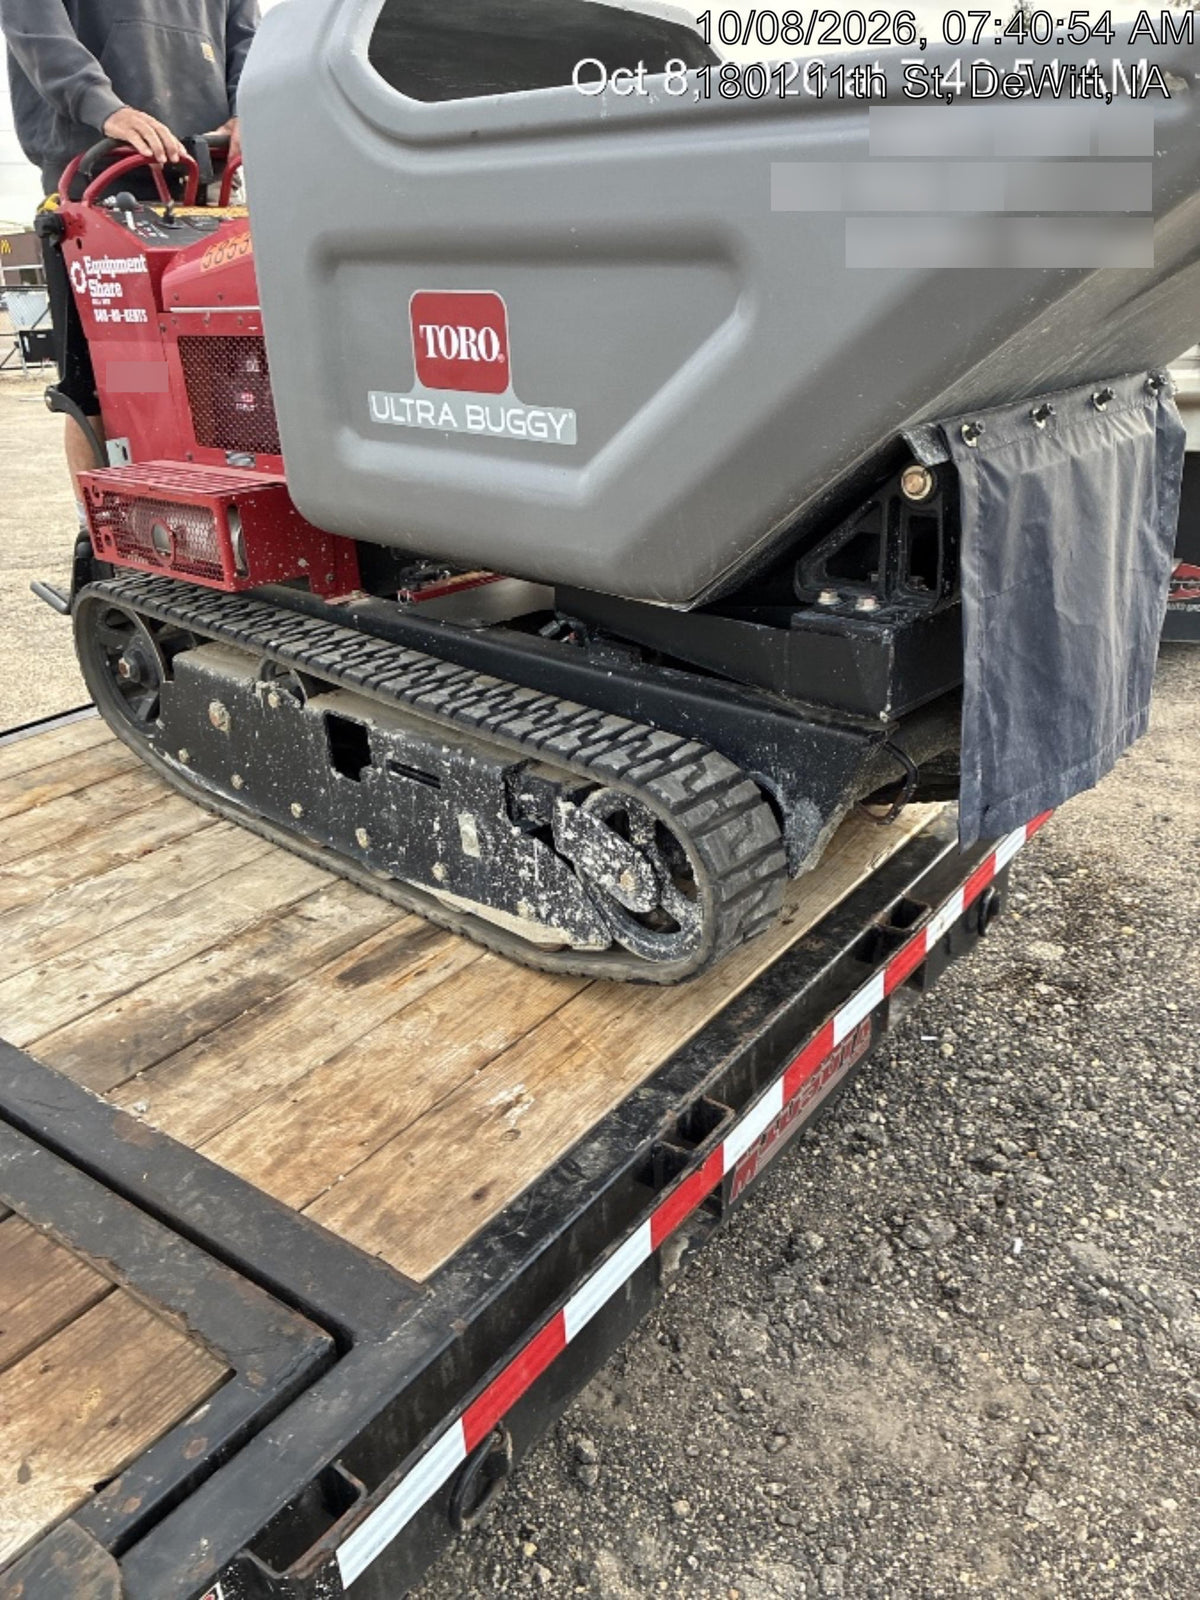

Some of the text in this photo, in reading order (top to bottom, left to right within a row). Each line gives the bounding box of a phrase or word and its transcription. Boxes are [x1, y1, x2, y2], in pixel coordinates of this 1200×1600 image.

[83, 254, 148, 279] Equipment
[88, 279, 123, 297] Share
[418, 324, 502, 362] TORO
[370, 395, 567, 440] ULTRA BUGGY
